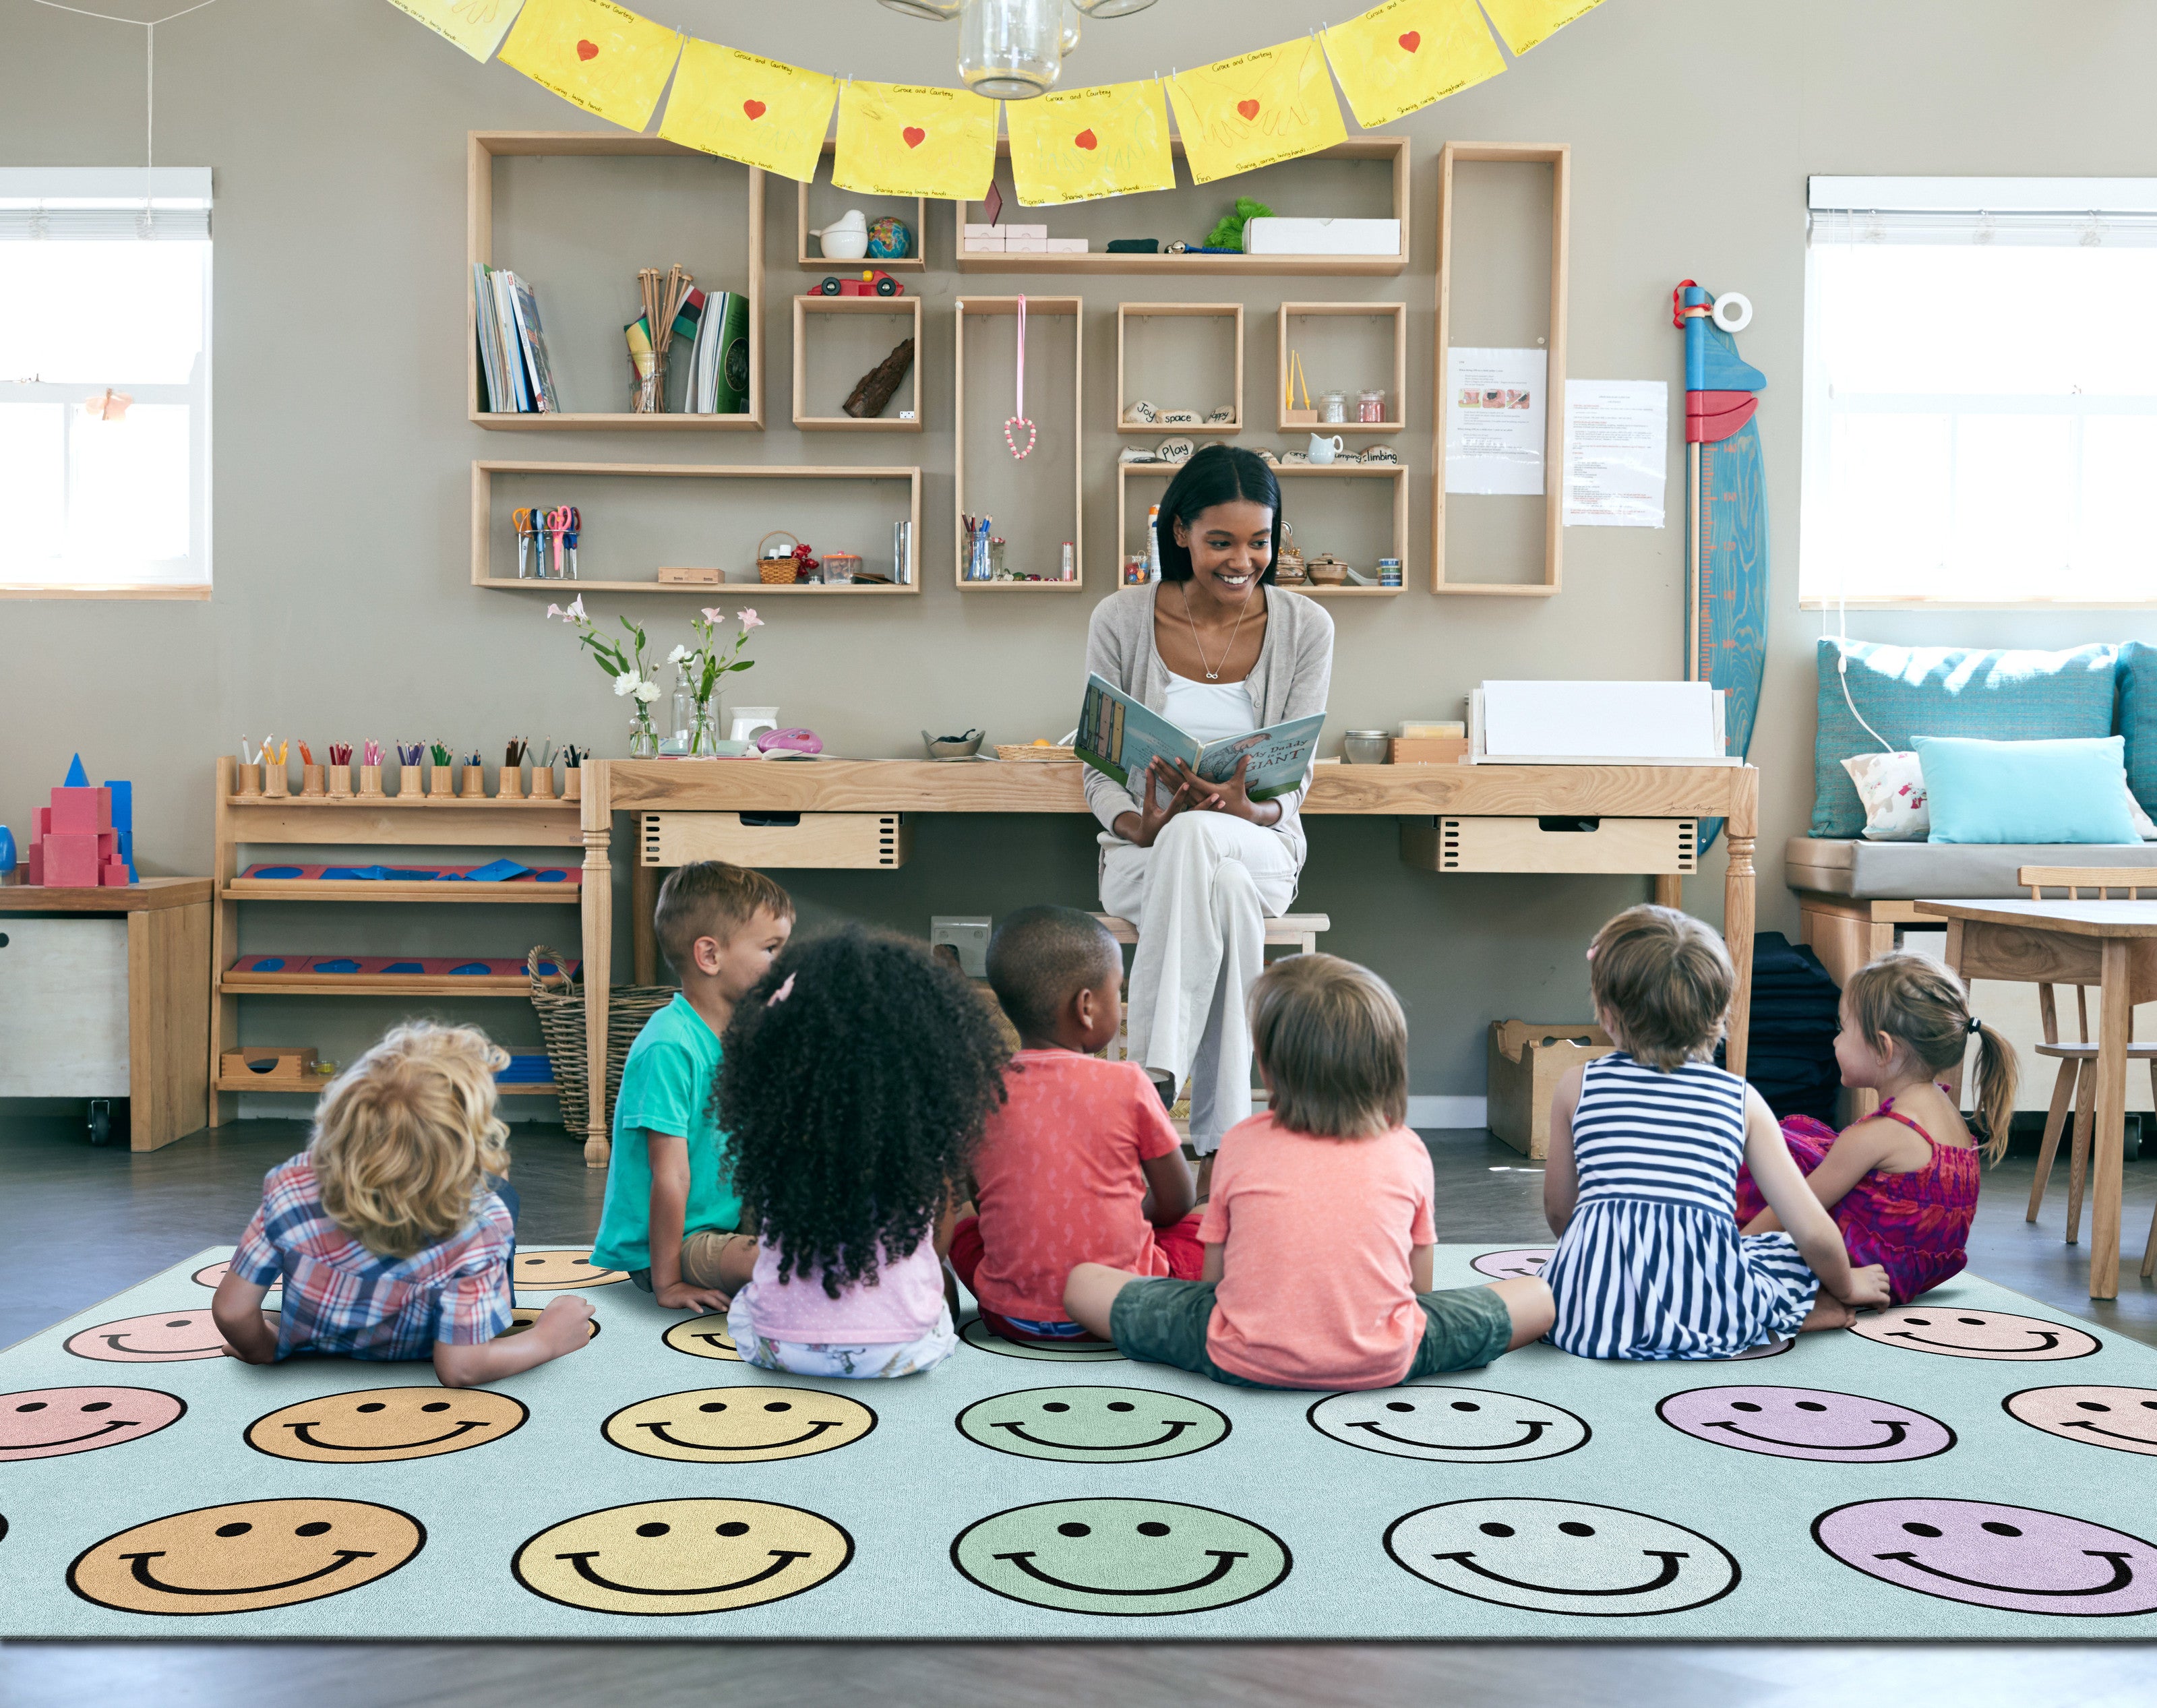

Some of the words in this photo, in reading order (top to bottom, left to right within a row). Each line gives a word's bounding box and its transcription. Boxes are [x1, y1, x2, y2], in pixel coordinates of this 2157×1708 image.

[1366, 9, 1384, 20] Grace
[1387, 1, 1397, 10] and
[1517, 39, 1538, 54] Caitlin
[733, 51, 752, 61] Grace
[1212, 63, 1230, 72] Grace
[1232, 58, 1244, 66] and
[1247, 51, 1272, 61] Courtesy
[893, 85, 913, 93] Grace
[1045, 93, 1064, 102] Grace
[1196, 173, 1211, 183] Finn
[1019, 197, 1045, 207] Thomas
[1137, 402, 1156, 423] Joy
[1165, 414, 1192, 423] space
[1162, 444, 1189, 461] Play
[1724, 444, 1737, 453] 140
[1334, 454, 1362, 463] umping
[1724, 541, 1736, 551] 120
[1271, 739, 1308, 754] Daddy
[1246, 748, 1305, 772] GIANT
